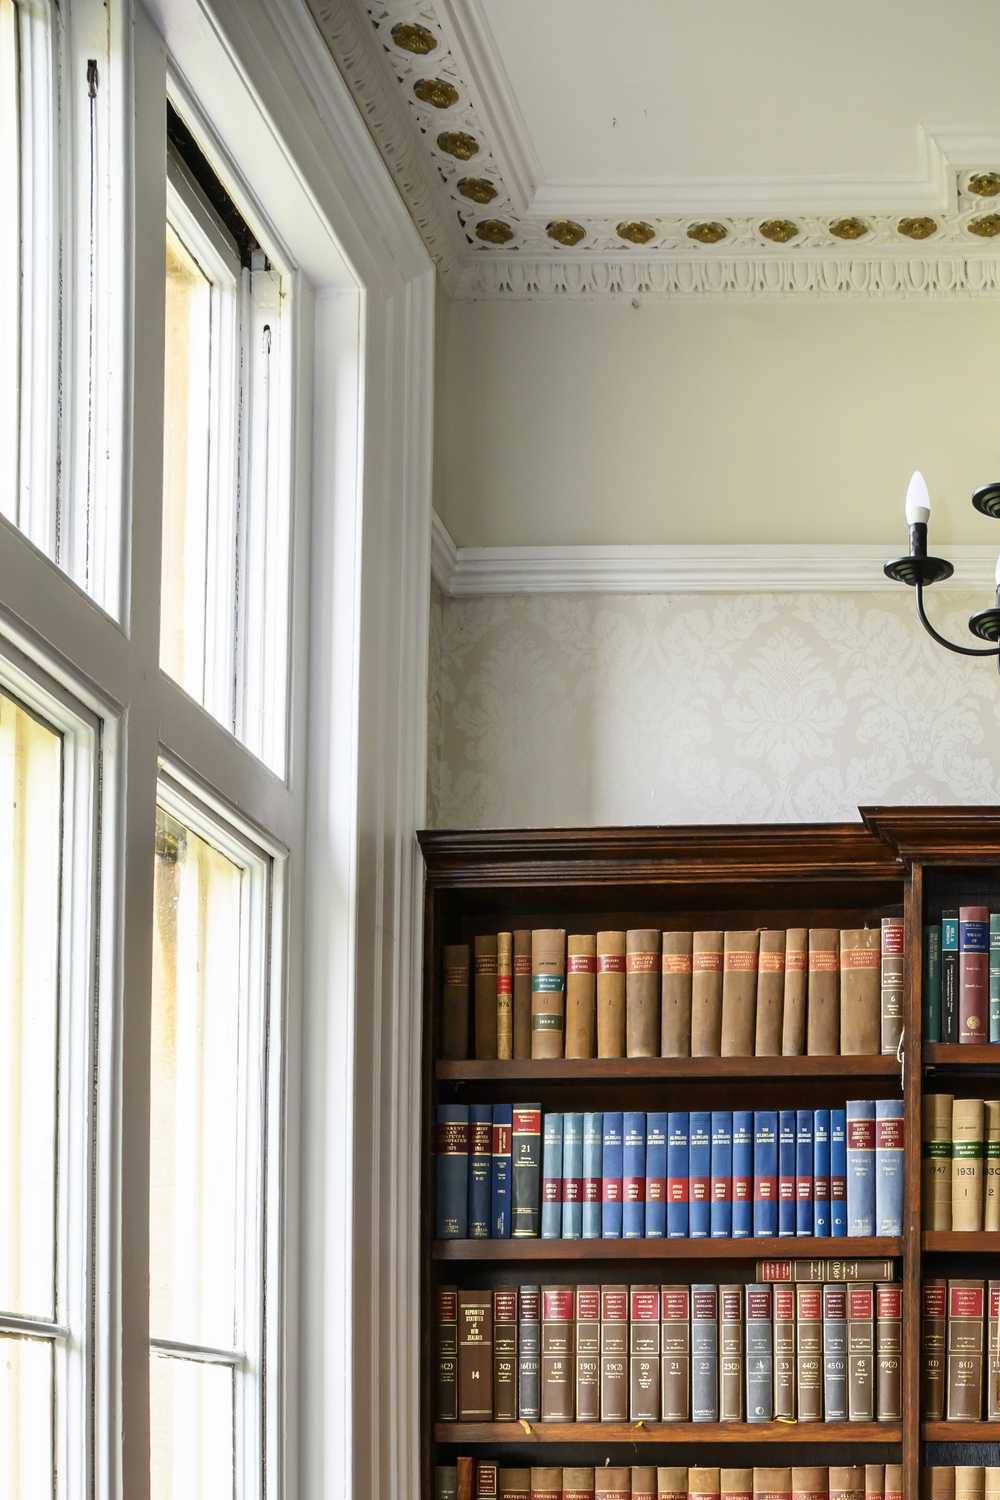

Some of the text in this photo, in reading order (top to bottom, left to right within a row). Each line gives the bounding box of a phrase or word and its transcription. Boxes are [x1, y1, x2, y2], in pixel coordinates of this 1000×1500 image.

[520, 1145, 530, 1153] 21
[957, 1167, 976, 1176] 1931
[580, 1363, 597, 1371] 19(1)
[606, 1363, 623, 1371] 19(2)
[724, 1363, 740, 1371] 23(2)
[801, 1361, 818, 1370] 44(2)
[827, 1362, 844, 1370] 45(1)
[880, 1361, 898, 1369] 49(2)
[472, 1371, 480, 1379] 14
